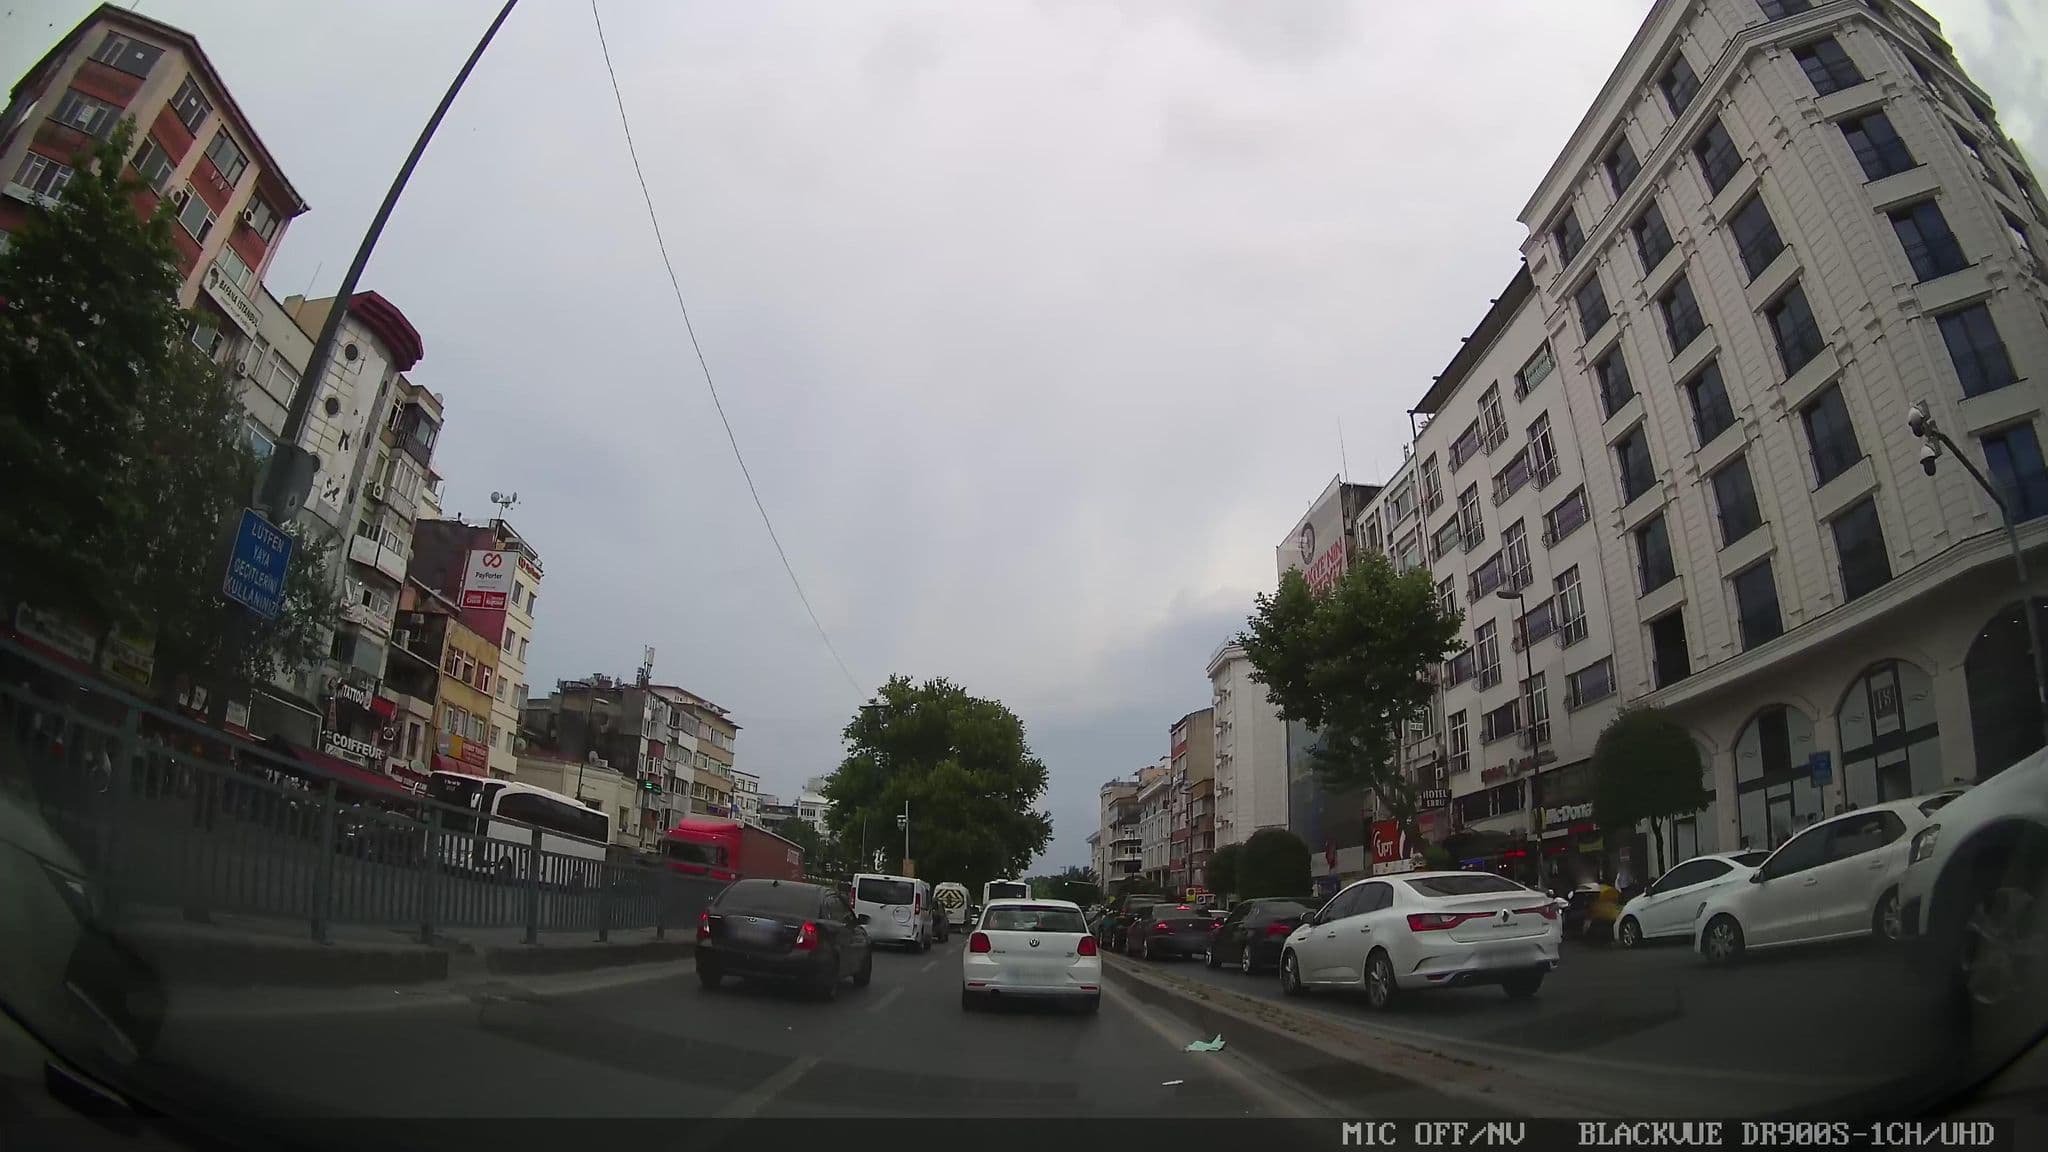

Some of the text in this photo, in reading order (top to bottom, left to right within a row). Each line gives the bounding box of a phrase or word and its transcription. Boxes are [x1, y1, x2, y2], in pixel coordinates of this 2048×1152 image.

[253, 545, 270, 568] YAYA
[332, 732, 383, 761] COIFFEUR
[1422, 789, 1448, 800] HOTEL
